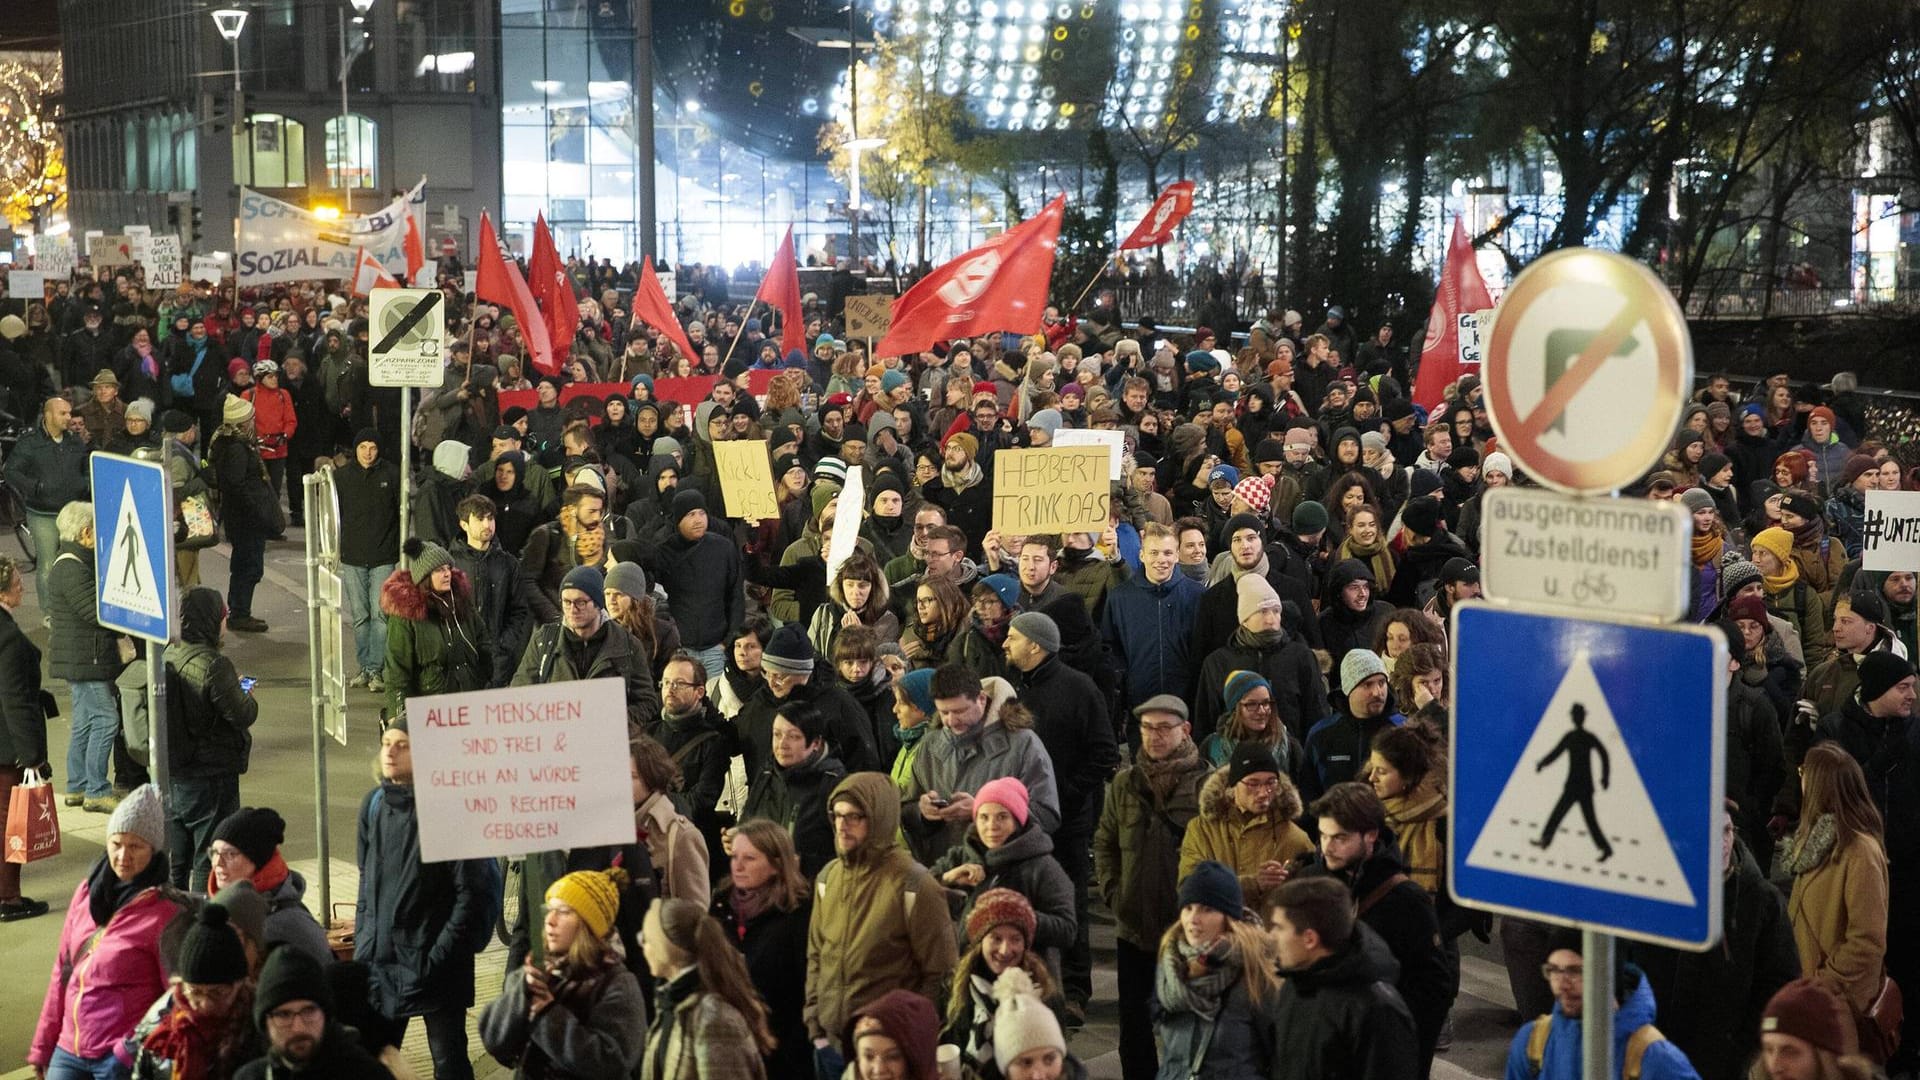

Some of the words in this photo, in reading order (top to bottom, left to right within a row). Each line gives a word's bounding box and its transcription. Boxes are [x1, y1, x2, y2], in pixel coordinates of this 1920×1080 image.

[151, 246, 174, 255] GUTE
[152, 271, 180, 284] ALLE
[1460, 315, 1477, 328] GE
[1002, 453, 1109, 488] HERBERT
[737, 489, 778, 515] RAUS
[993, 492, 1063, 528] TRINK
[1066, 491, 1109, 525] DAS
[1494, 500, 1675, 536] ausgenommen
[1863, 509, 1920, 550] #UNTE
[1504, 529, 1661, 571] Zustelldienst
[426, 706, 471, 727] ALLE
[485, 701, 582, 725] MENSCHEN
[462, 738, 497, 755] SIND
[504, 735, 541, 753] FREI
[554, 731, 567, 752] &
[431, 769, 486, 787] GLEICH
[496, 768, 518, 784] AN
[530, 765, 581, 783] WÜRDE
[464, 799, 498, 815] UND
[511, 795, 576, 814] RECHTEN
[483, 822, 559, 840] GEBOREN
